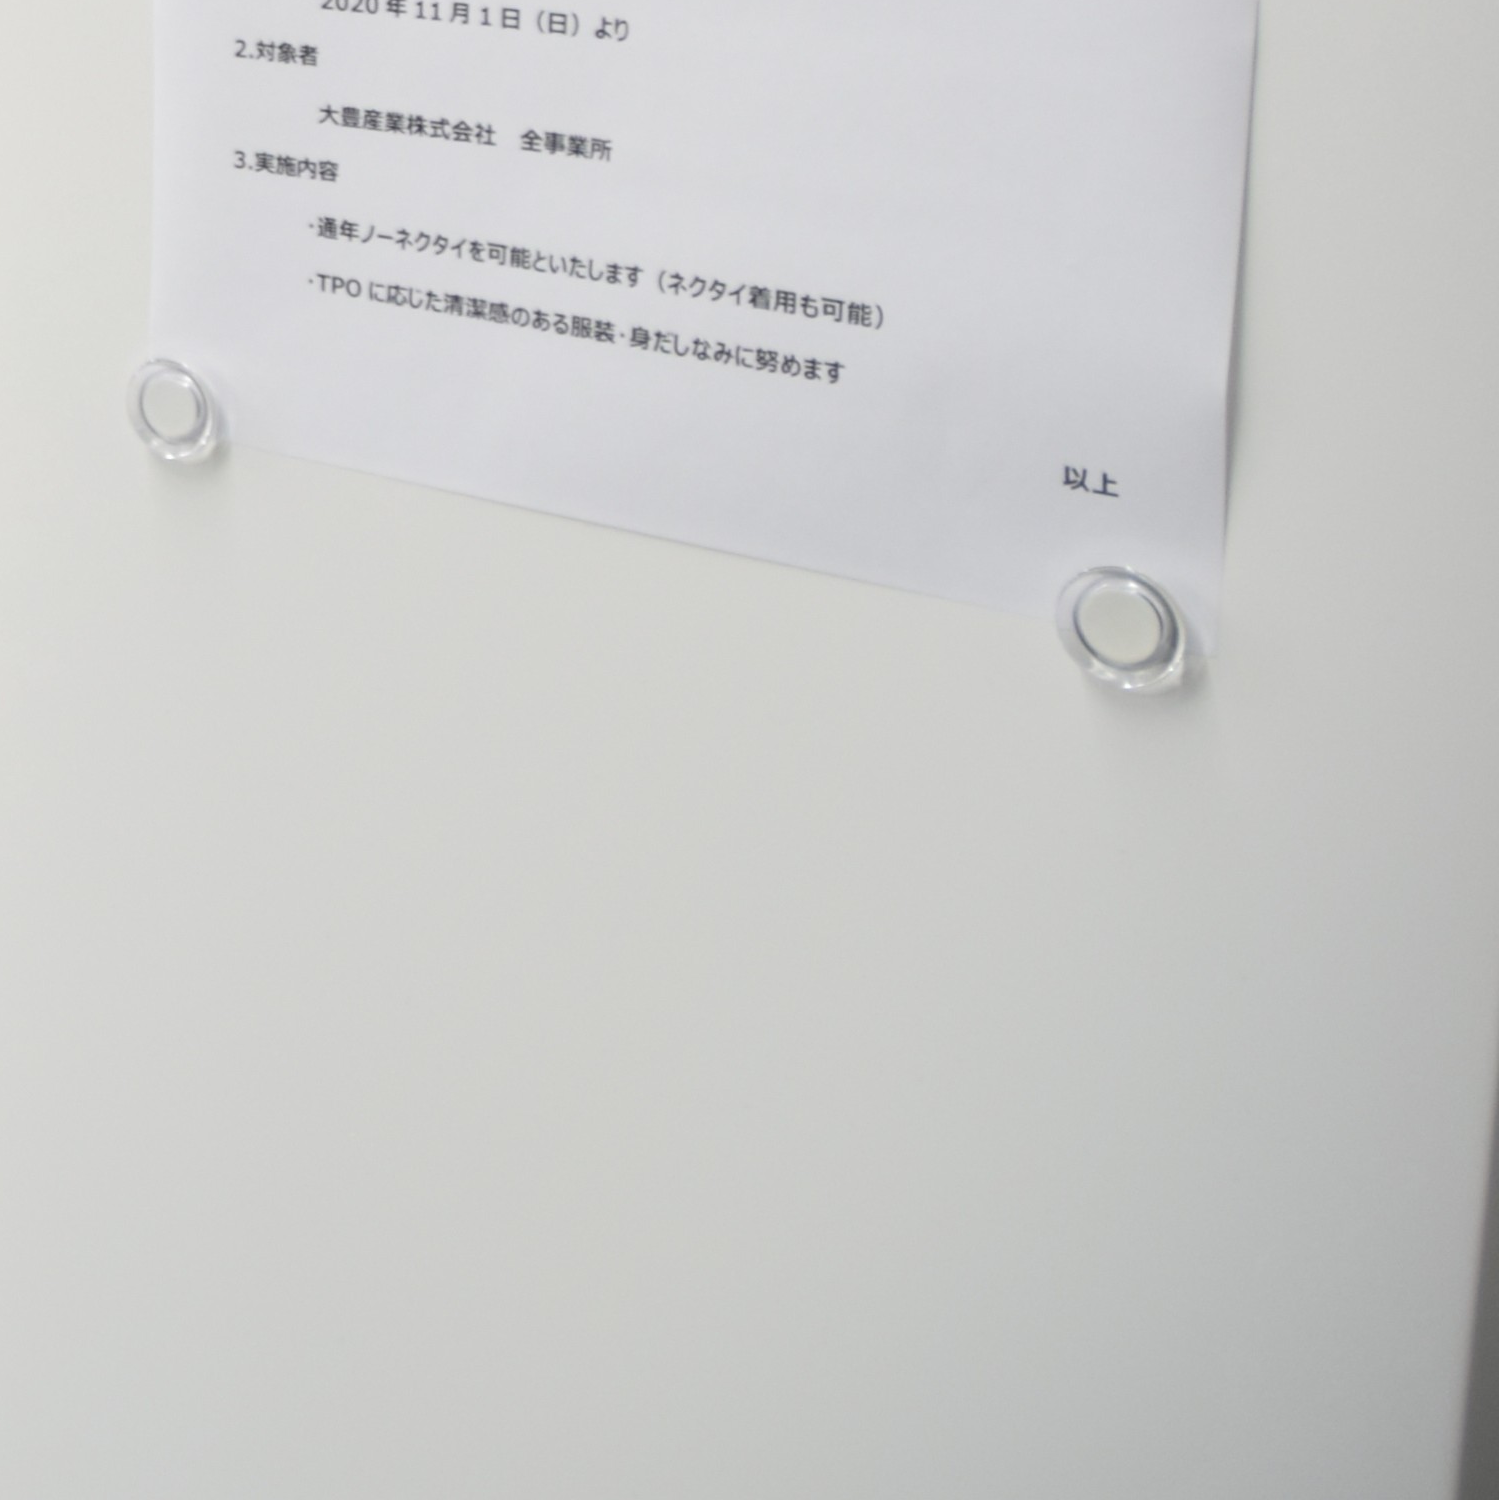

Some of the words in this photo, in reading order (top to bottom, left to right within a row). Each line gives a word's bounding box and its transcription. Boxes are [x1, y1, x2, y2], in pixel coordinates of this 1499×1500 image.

[235, 39, 318, 66] 2.対象者
[319, 105, 496, 146] 大豊産業株式会社
[521, 129, 612, 161] 全事業所
[235, 151, 338, 182] 3.実施内容
[1063, 466, 1119, 497] 以上
